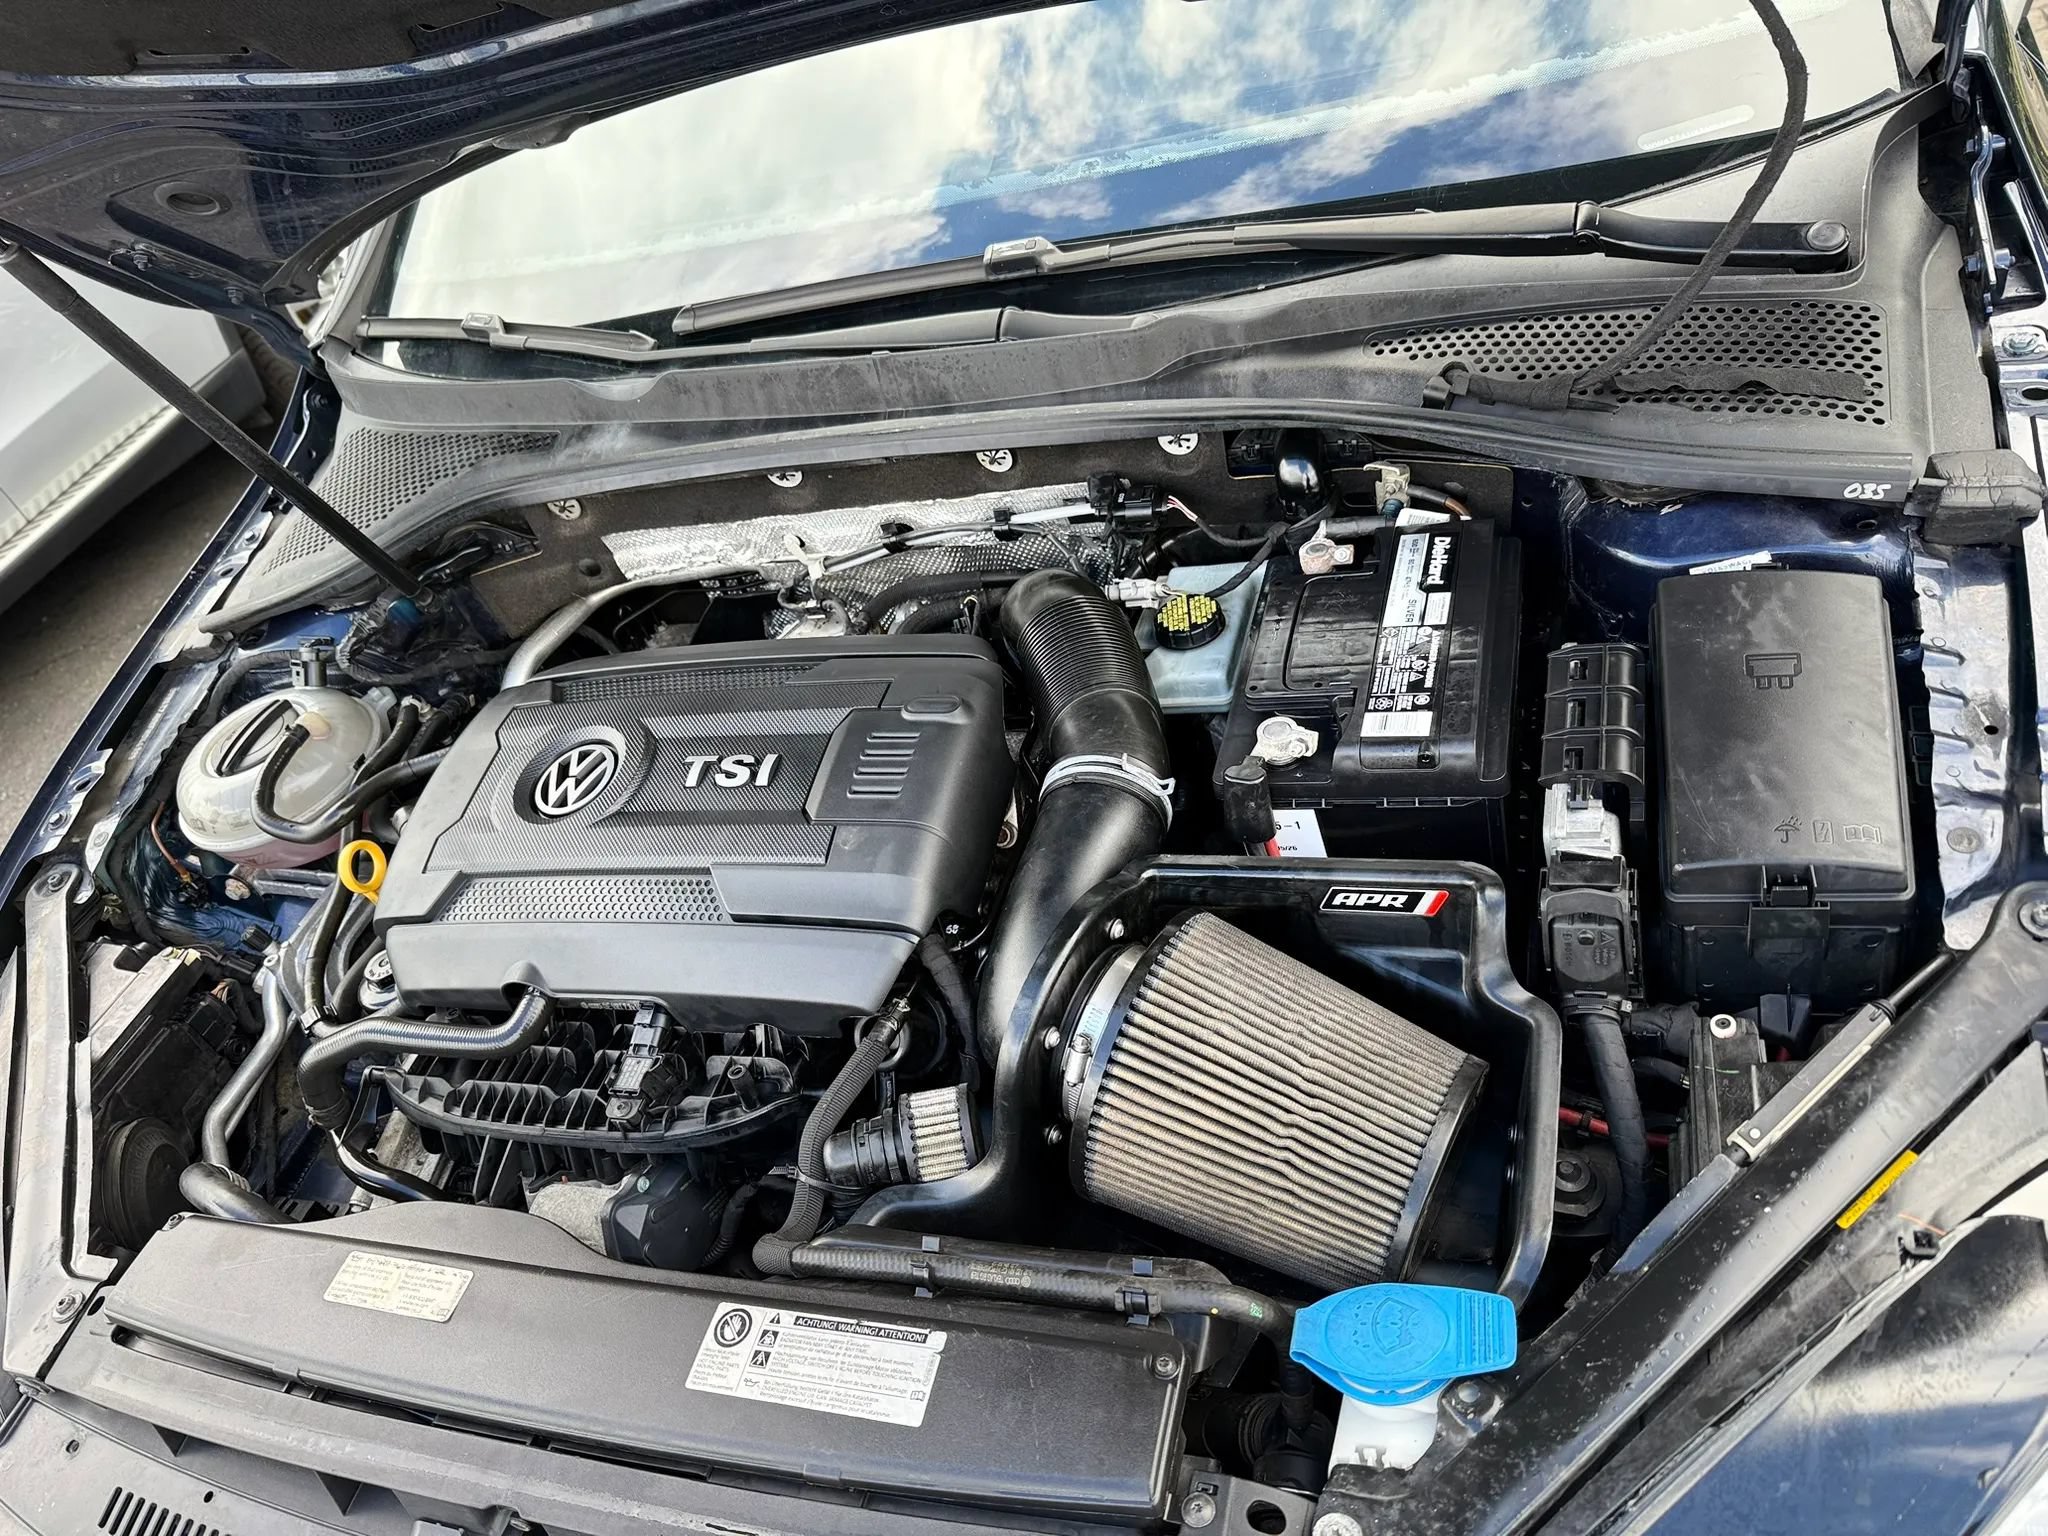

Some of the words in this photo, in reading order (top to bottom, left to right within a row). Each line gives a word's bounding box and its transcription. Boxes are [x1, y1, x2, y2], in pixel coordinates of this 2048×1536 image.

[1427, 536, 1451, 585] DieHard
[1404, 599, 1417, 623] SILVER
[684, 753, 780, 789] TSI
[1331, 893, 1409, 909] APR
[795, 1318, 838, 1331] ACHTUNG!
[837, 1322, 879, 1336] WARNING!
[878, 1329, 926, 1343] ATTENTION!
